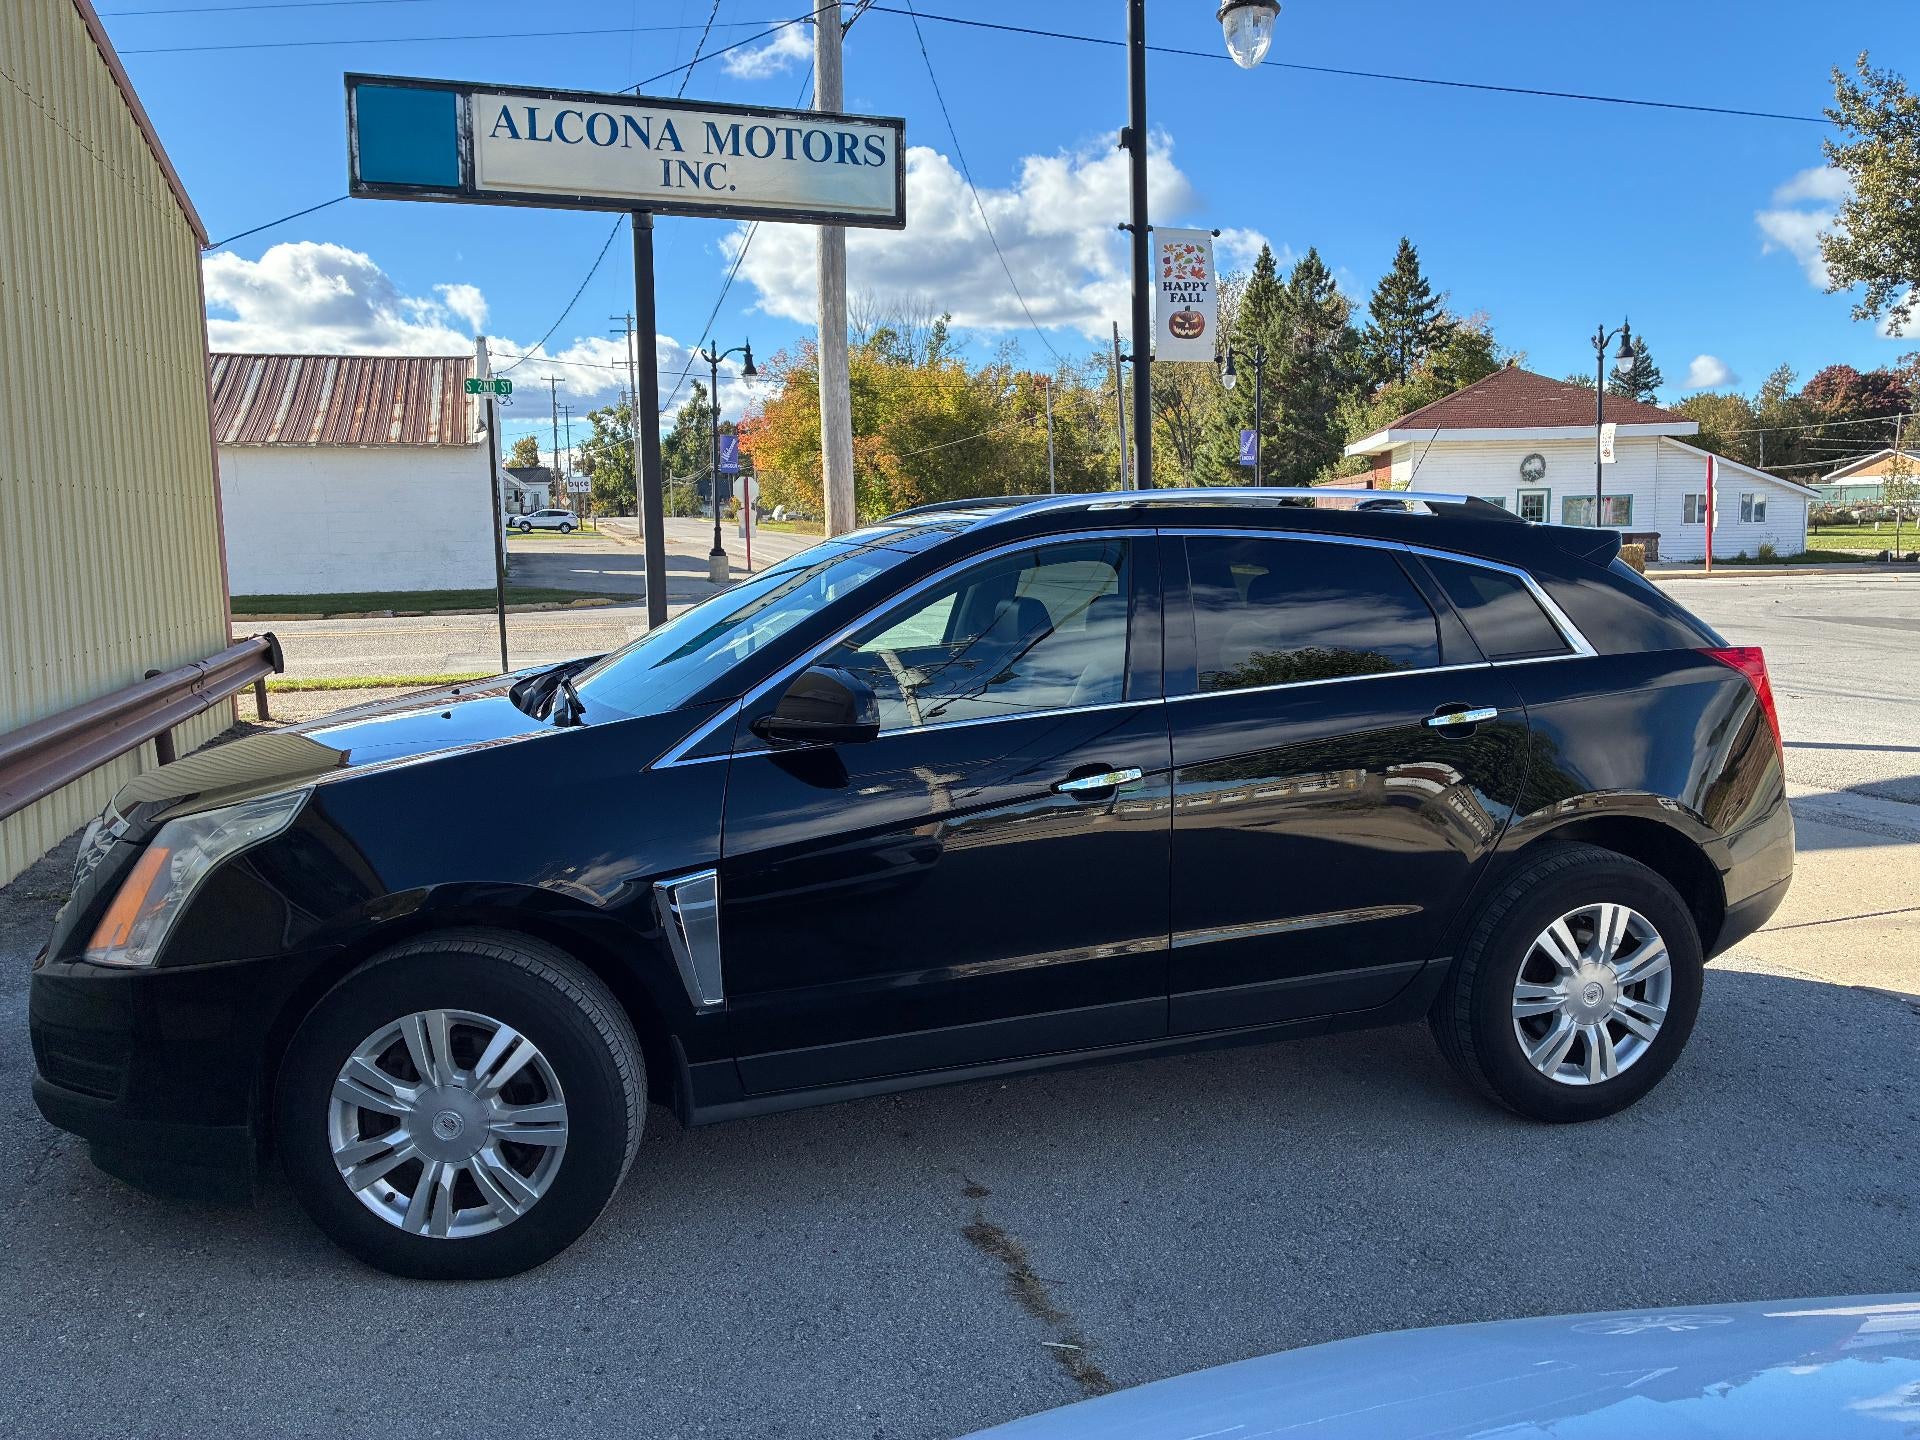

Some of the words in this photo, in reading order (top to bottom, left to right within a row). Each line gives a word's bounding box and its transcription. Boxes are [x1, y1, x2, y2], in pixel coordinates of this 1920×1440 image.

[488, 104, 686, 152] ALCONA
[702, 120, 886, 168] MOTORS
[659, 158, 737, 192] INC.
[1162, 281, 1209, 292] HAPPY
[1169, 292, 1204, 303] FALL
[465, 380, 472, 392] S
[477, 380, 496, 392] 2ND
[500, 381, 511, 393] ST
